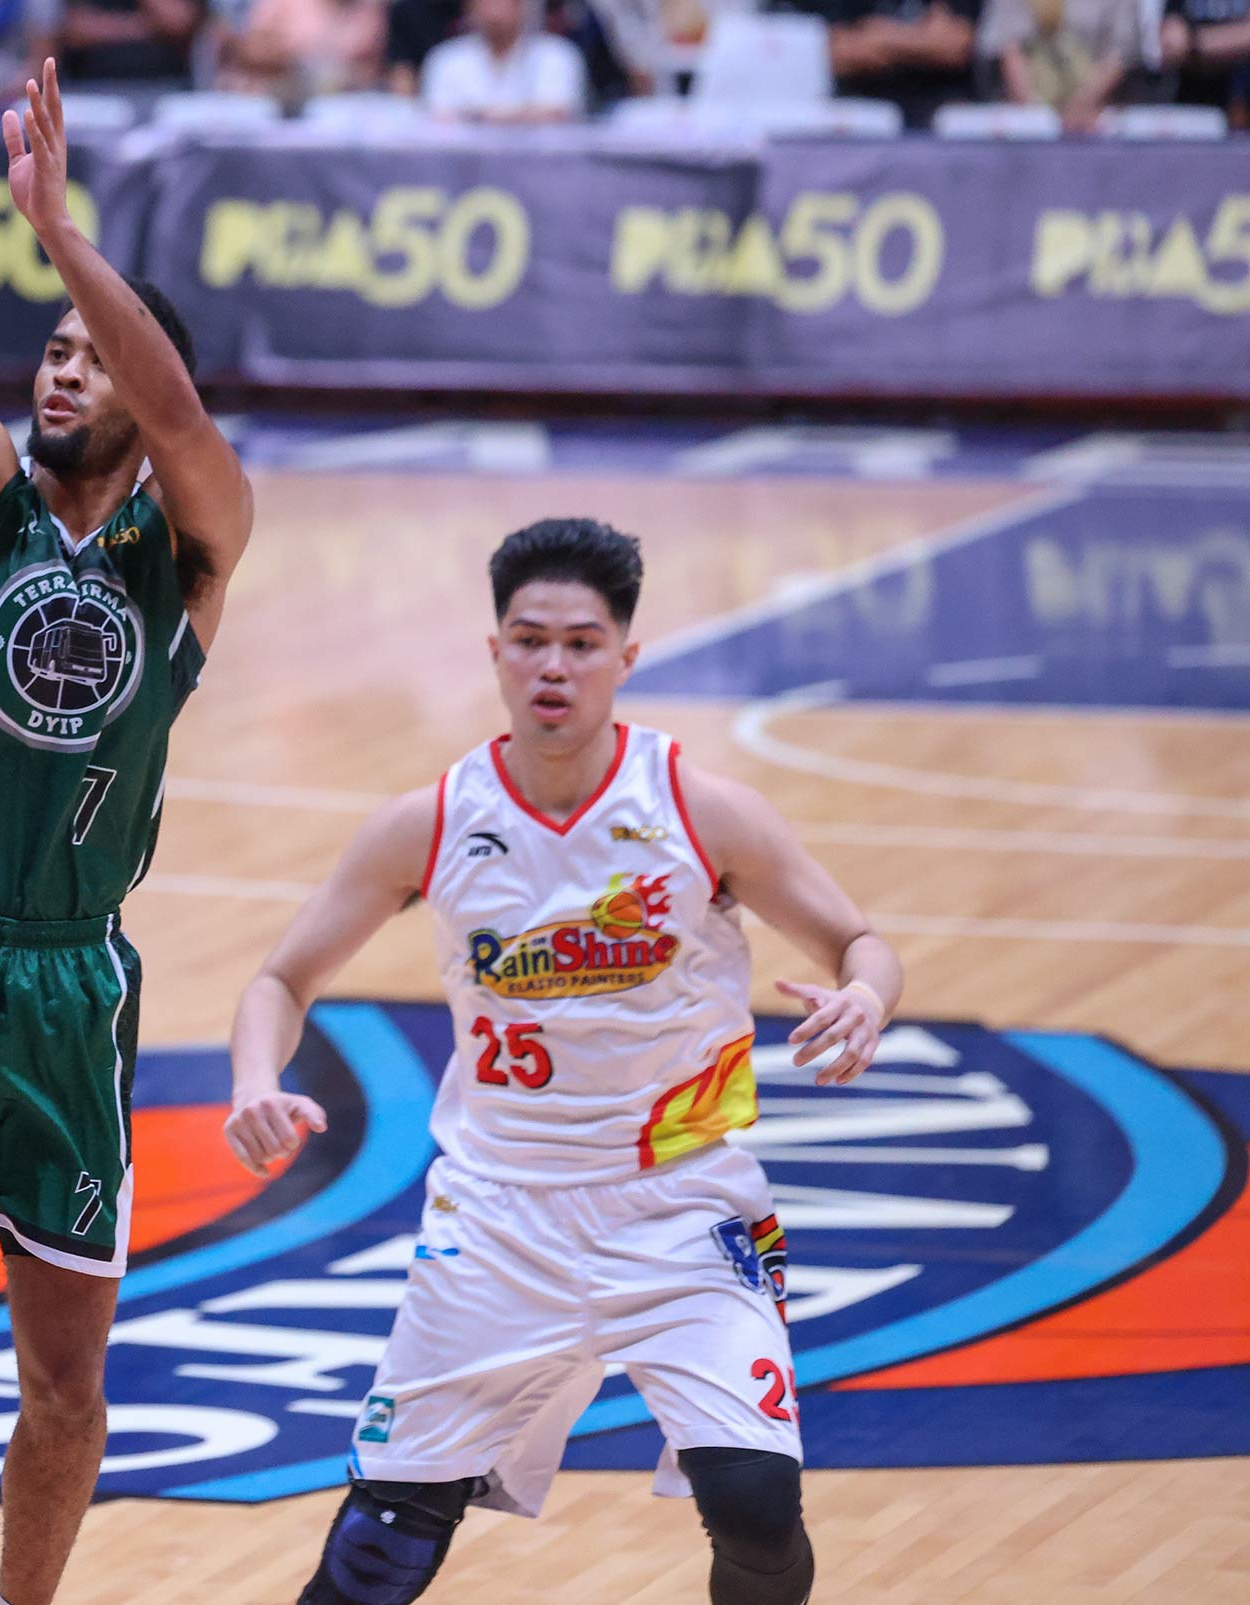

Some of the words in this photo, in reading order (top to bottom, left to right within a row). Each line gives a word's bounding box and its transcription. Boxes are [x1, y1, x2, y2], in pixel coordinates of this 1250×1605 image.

[27, 710, 84, 735] DYIP
[71, 765, 117, 845] 7
[467, 928, 550, 986] Rain
[551, 927, 678, 974] Shine
[470, 1015, 554, 1089] 25
[71, 1170, 103, 1236] 7
